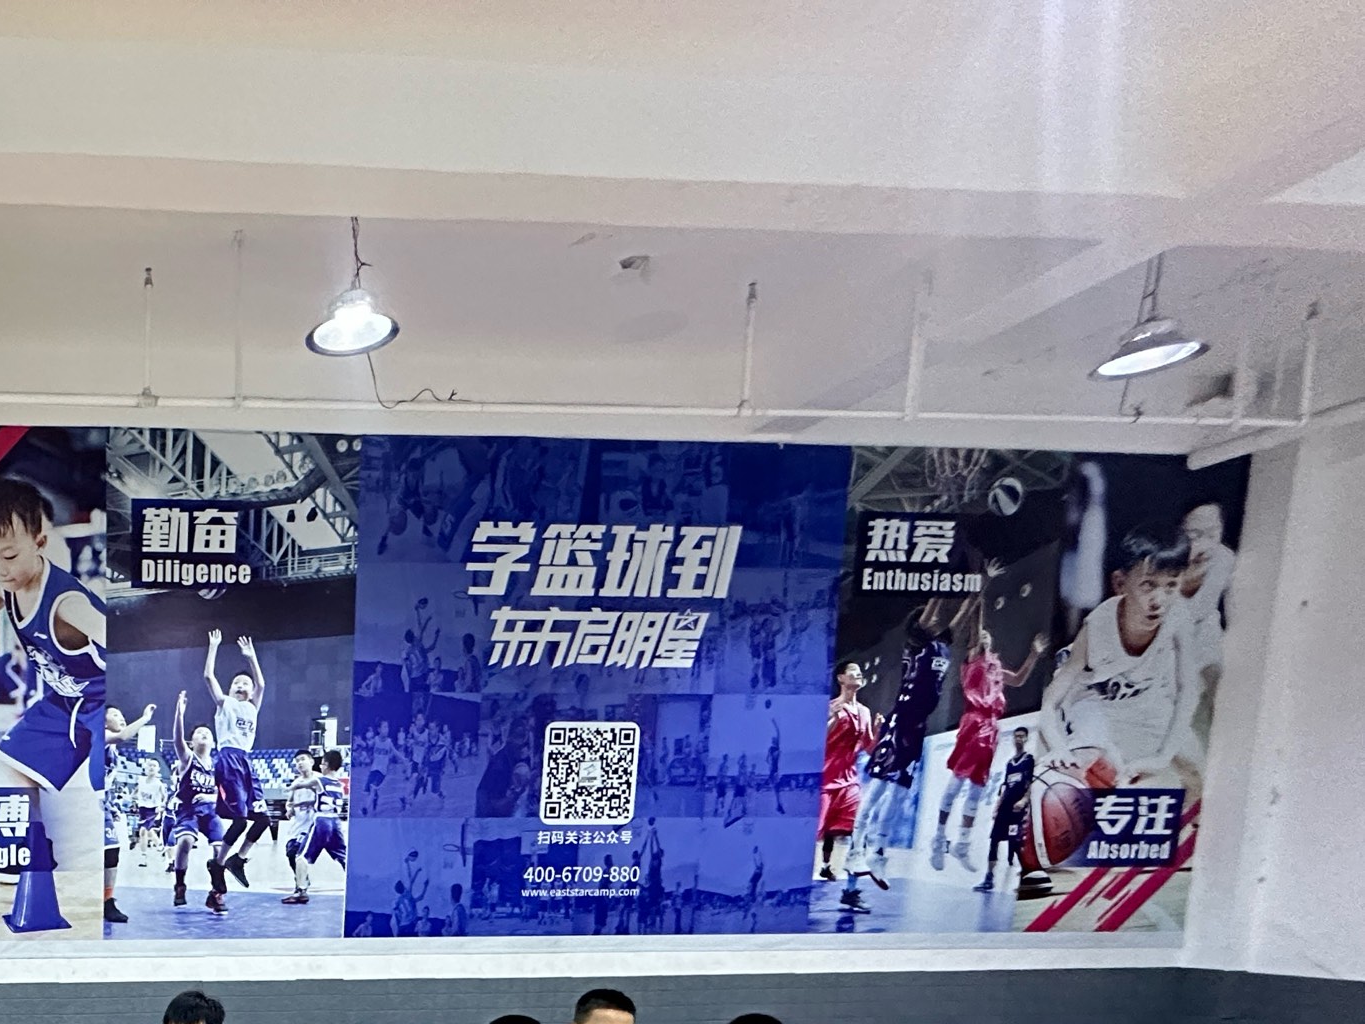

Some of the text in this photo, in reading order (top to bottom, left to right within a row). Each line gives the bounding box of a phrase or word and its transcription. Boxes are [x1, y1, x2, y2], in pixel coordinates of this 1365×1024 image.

[141, 507, 239, 553] 勤奋
[865, 518, 956, 563] 热爱
[141, 559, 252, 586] Diligence
[466, 521, 743, 598] 学篮球到
[862, 567, 982, 592] Enthusiasm
[488, 606, 710, 669] 东方启明星
[1094, 794, 1177, 835] 专注
[537, 830, 633, 845] 扫码关注公众号
[1087, 840, 1171, 859] Absorbed
[523, 866, 640, 883] 400-6709-880
[521, 887, 640, 899] www.eaststarcamp.com
